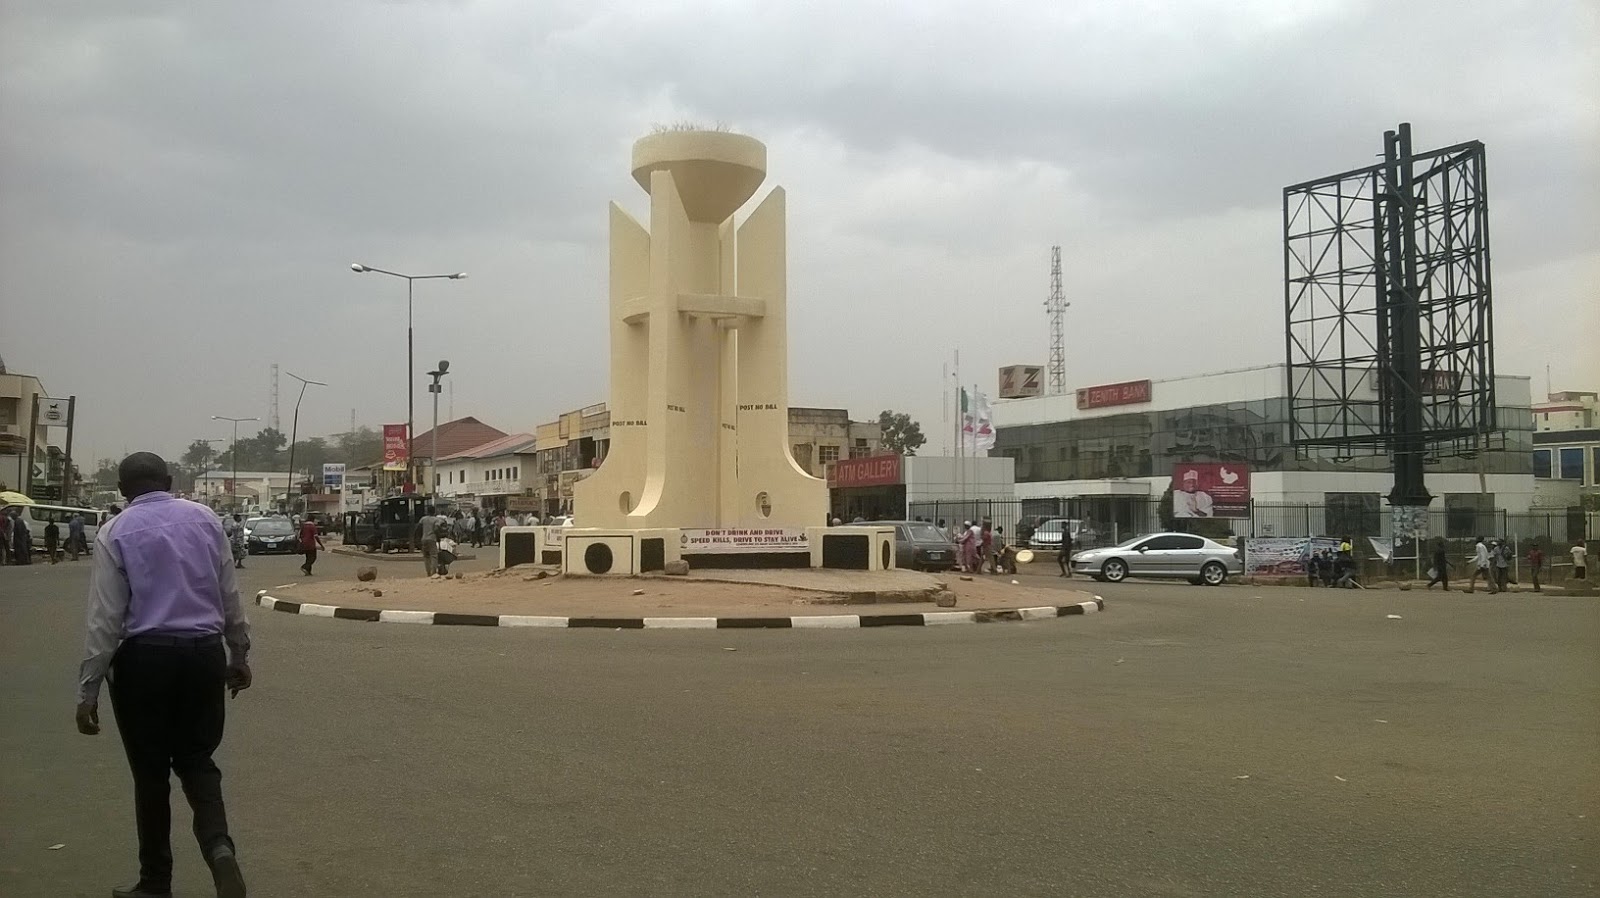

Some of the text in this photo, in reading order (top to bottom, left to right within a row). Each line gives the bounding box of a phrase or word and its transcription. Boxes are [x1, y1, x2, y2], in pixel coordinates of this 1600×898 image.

[1090, 388, 1119, 404] ZENITH
[1123, 384, 1147, 400] BANK
[839, 460, 898, 482] ATM GALLERY
[713, 536, 732, 544] KILLS,
